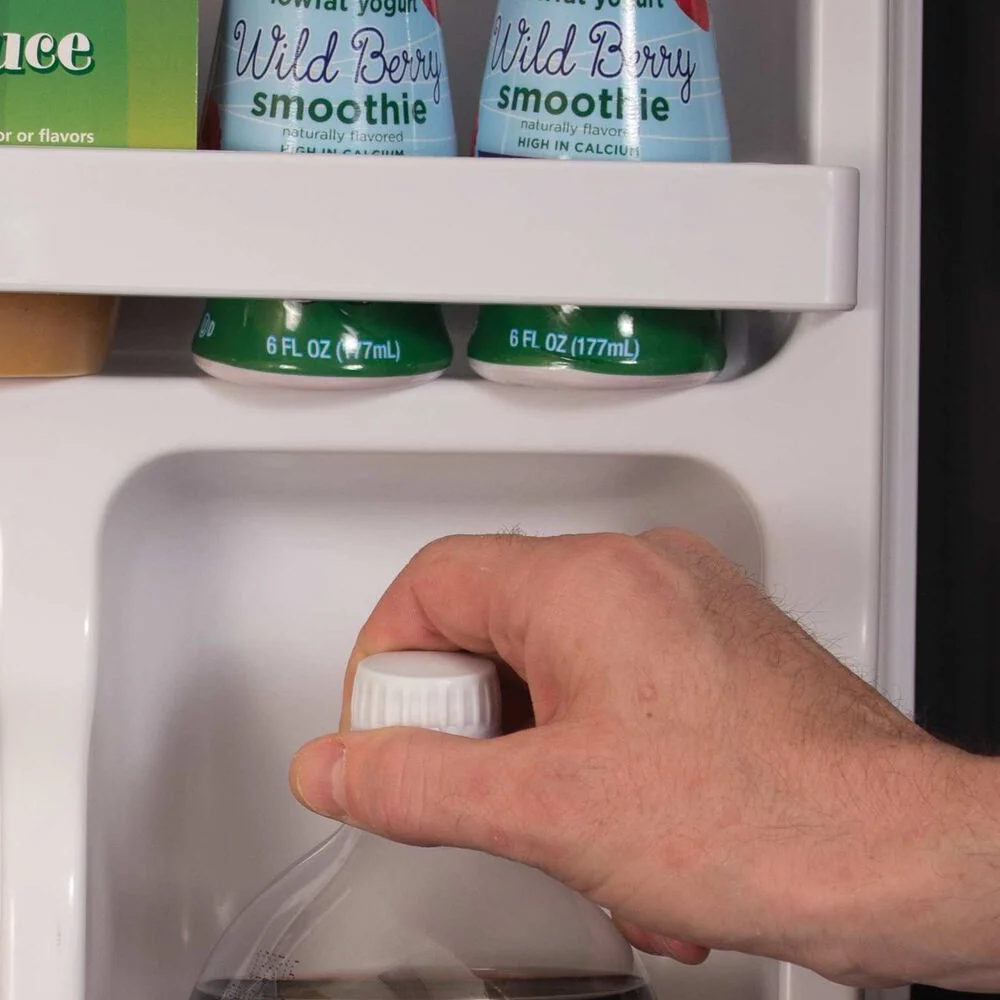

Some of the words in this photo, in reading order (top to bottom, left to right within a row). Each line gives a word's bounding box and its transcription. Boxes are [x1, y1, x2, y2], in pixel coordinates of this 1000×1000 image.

[490, 15, 577, 77] Wild
[234, 19, 339, 84] Wild
[351, 26, 442, 104] Berry
[251, 91, 427, 125] smoothie
[16, 130, 34, 143] or
[38, 128, 95, 143] flavors
[282, 128, 345, 143] naturally
[350, 130, 404, 142] flavored
[520, 119, 578, 136] naturally
[517, 136, 550, 149] HIGH
[554, 141, 569, 152] IN
[266, 335, 277, 355] 6
[281, 336, 303, 357] FL
[307, 338, 332, 359] OZ
[509, 328, 519, 347] 6
[522, 329, 540, 349] FL
[545, 332, 568, 353] OZ
[570, 336, 640, 361] (177mL)
